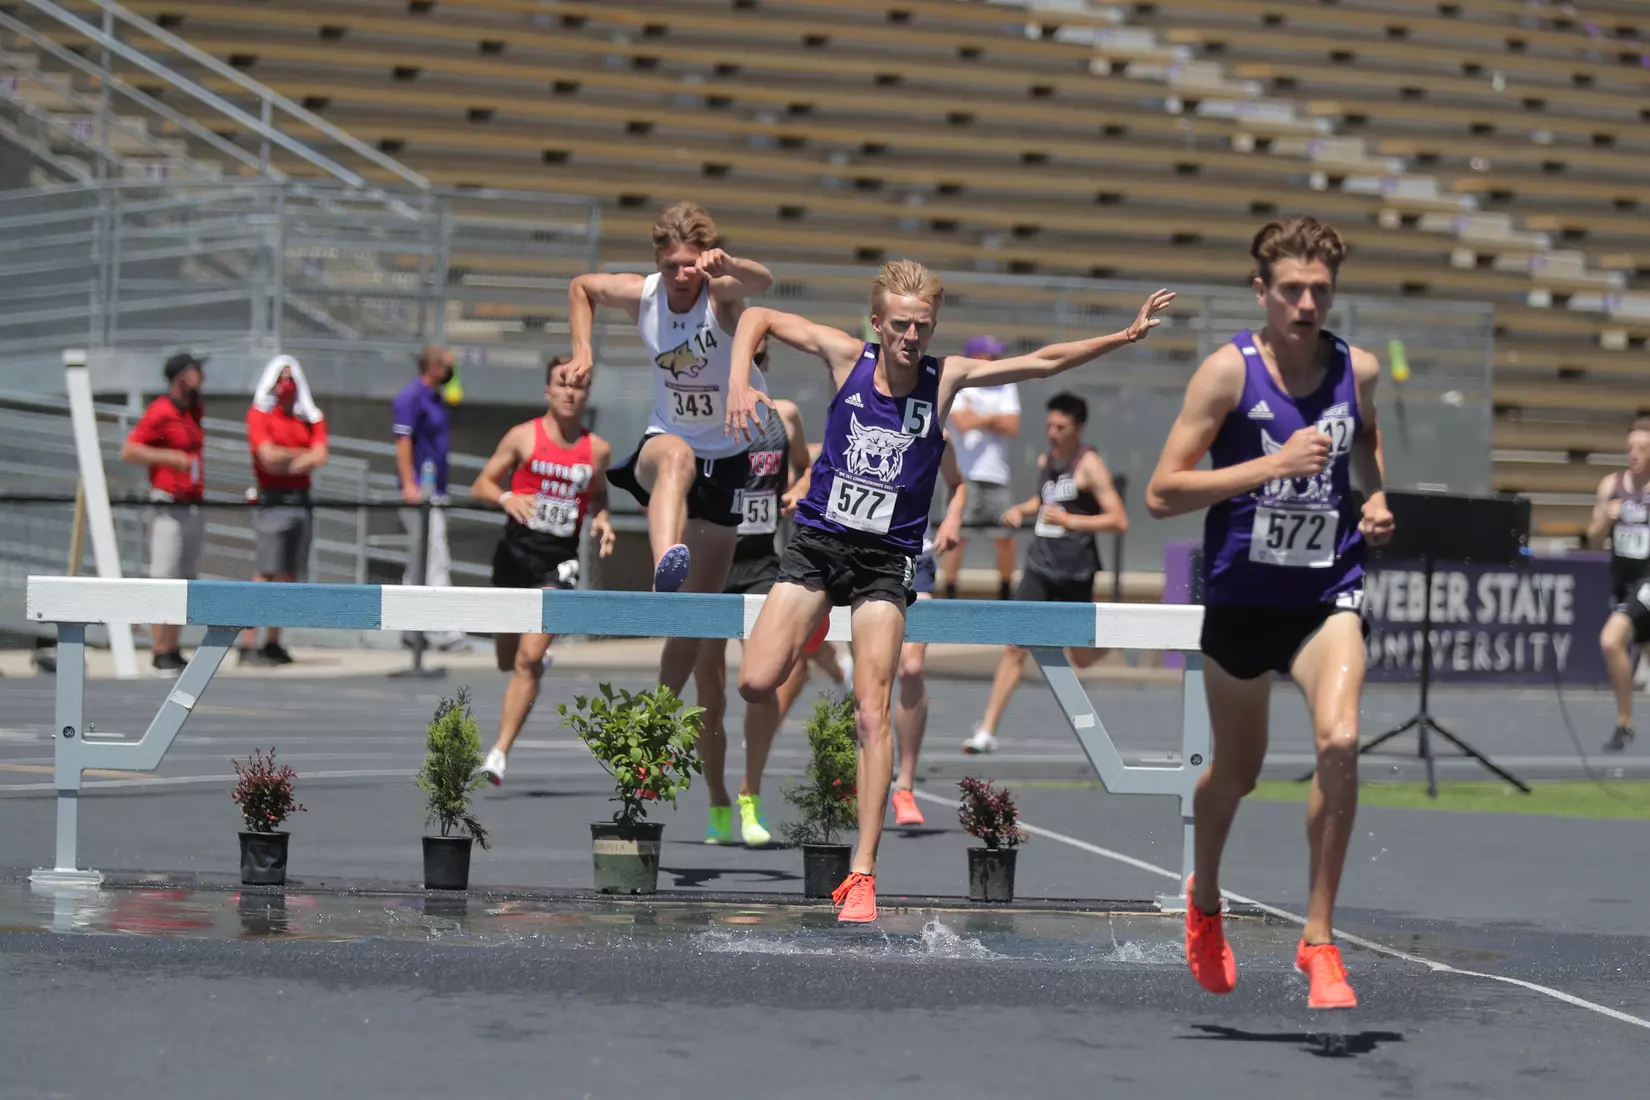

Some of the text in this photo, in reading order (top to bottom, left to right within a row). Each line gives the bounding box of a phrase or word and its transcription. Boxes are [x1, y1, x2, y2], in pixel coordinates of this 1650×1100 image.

[695, 329, 718, 353] 14
[673, 391, 714, 416] 343
[908, 402, 928, 435] 5
[1324, 421, 1348, 452] 12
[748, 500, 769, 523] 53
[837, 483, 886, 521] 577
[1266, 513, 1326, 550] 572
[1362, 570, 1575, 625] WEBER STATE
[1364, 629, 1573, 673] UNIVERSITY
